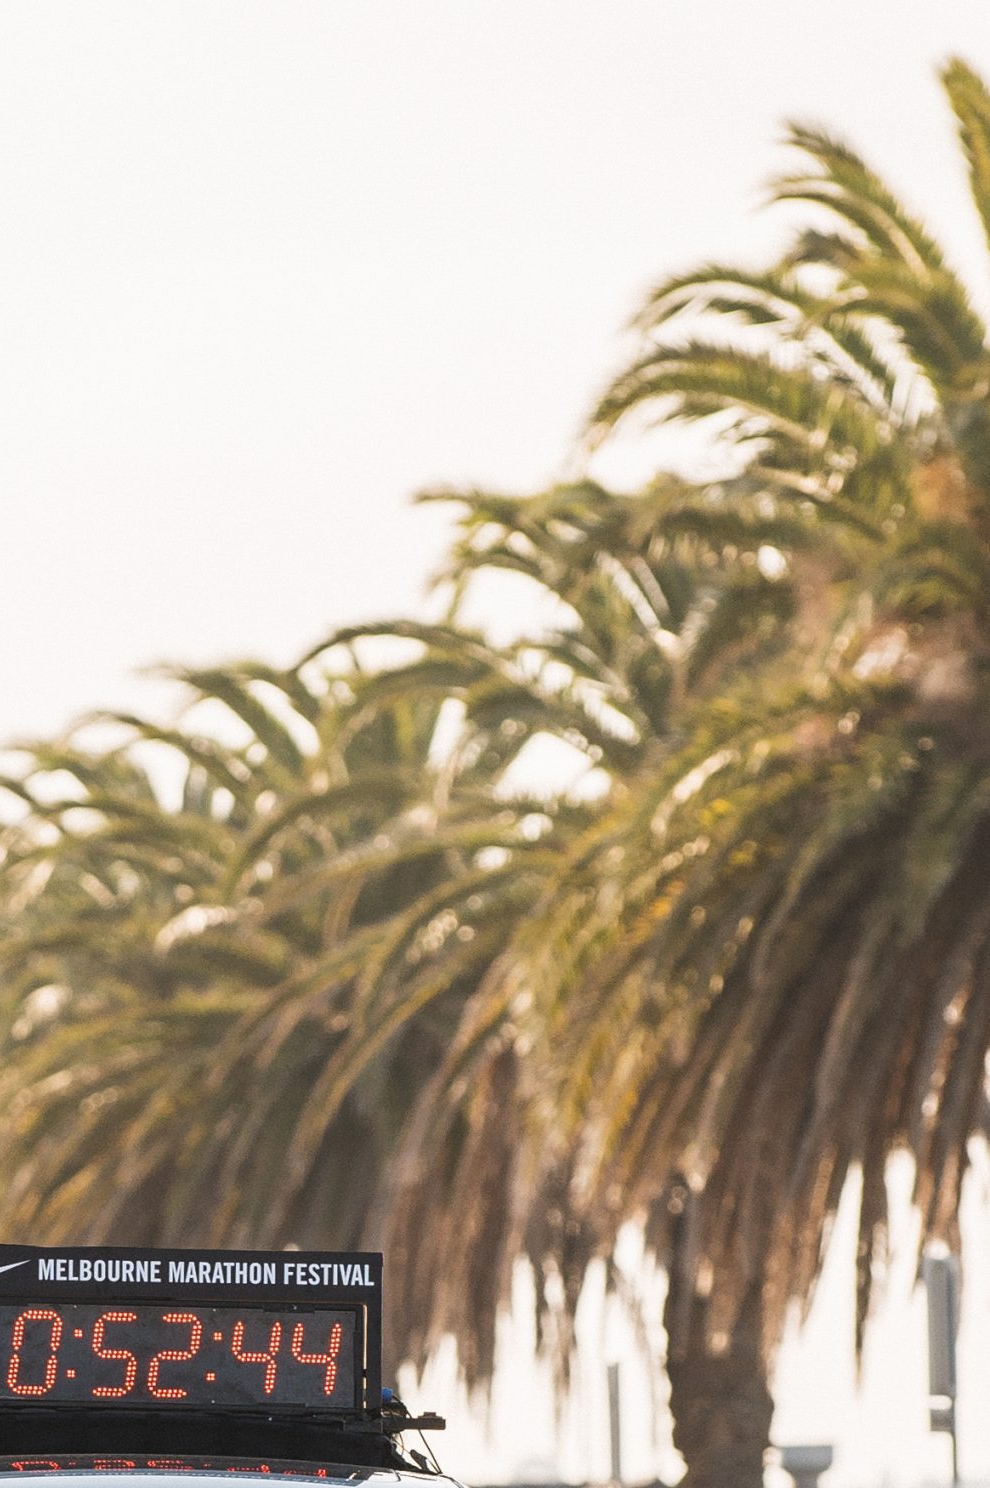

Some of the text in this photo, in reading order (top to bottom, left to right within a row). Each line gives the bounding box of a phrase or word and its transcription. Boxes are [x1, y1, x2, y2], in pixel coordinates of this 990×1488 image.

[38, 1259, 375, 1287] MELBOURNE MARATHON FESTIVAL
[7, 1309, 342, 1397] 0:52:44
